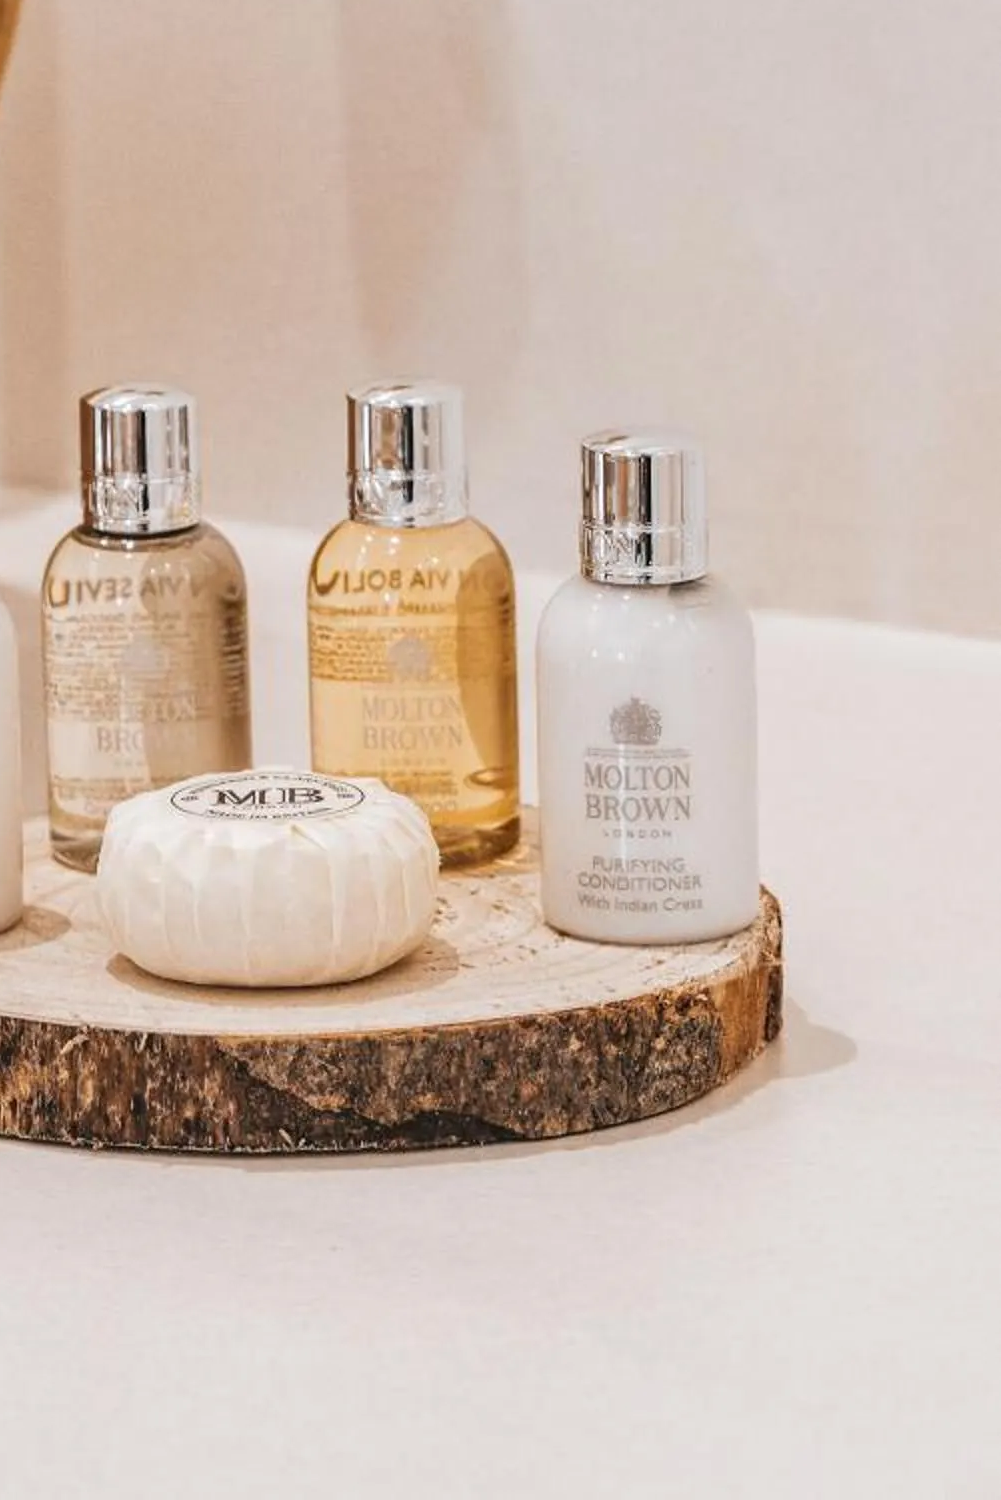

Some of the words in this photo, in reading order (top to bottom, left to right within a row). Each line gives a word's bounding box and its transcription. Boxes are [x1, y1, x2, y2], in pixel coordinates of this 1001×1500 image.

[362, 695, 463, 723] MOLTON
[363, 723, 464, 751] BROWN
[583, 761, 691, 792] MOLTON
[585, 793, 692, 823] BROWN
[602, 828, 673, 840] LONDON
[591, 855, 686, 874] PURIFYING
[577, 872, 703, 892] CONDITIONER
[577, 892, 611, 911] With
[613, 897, 659, 913] Indian
[662, 895, 704, 912] Cress
